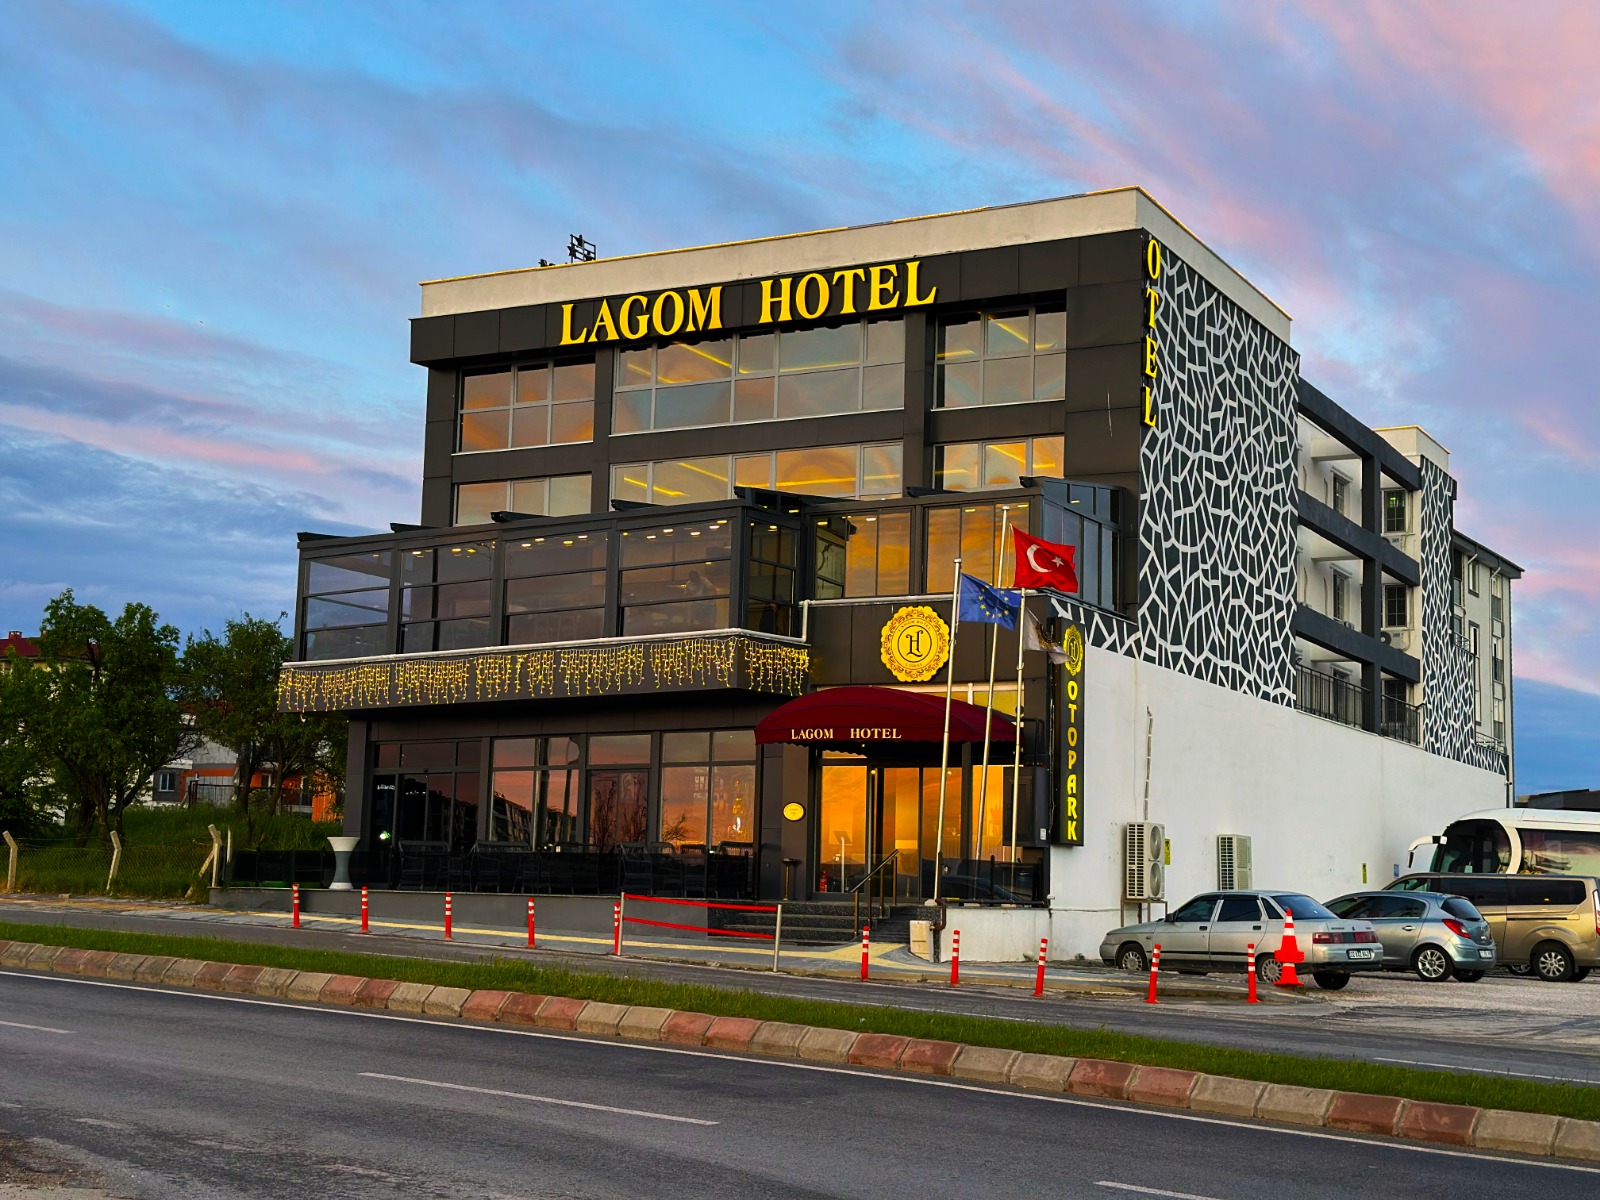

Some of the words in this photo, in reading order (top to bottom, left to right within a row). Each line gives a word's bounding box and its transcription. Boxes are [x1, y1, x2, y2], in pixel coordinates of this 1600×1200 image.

[559, 285, 723, 346] LAGOM
[758, 261, 937, 324] HOTEL
[1144, 239, 1161, 428] OTEL
[791, 728, 834, 740] LAGOM
[850, 728, 902, 739] HOTEL
[1066, 680, 1079, 842] OTOPARK
